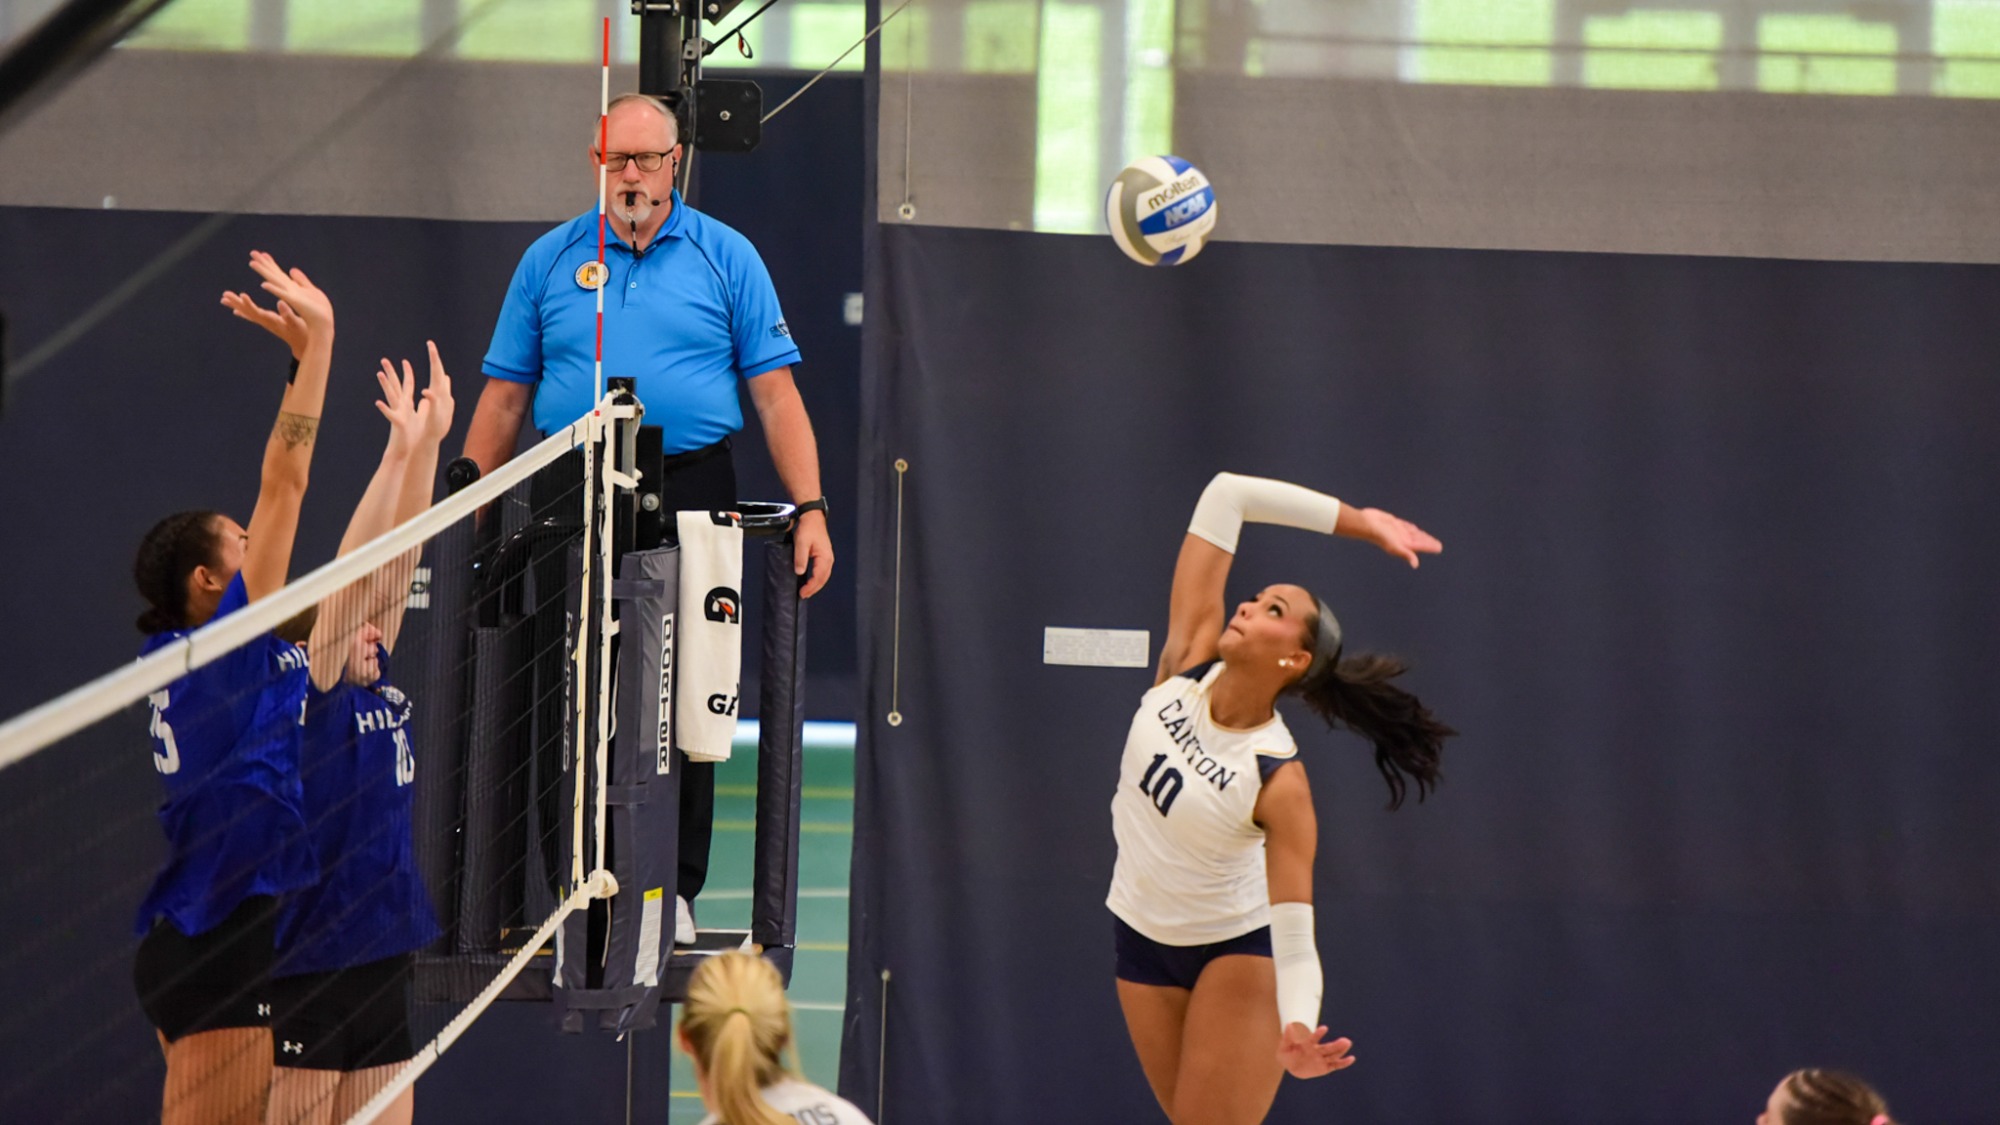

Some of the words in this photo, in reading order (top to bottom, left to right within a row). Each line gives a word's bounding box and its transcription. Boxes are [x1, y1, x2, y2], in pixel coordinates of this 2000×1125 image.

[1148, 175, 1200, 210] molten
[1163, 191, 1207, 229] NCAA
[704, 586, 740, 624] G
[392, 728, 415, 787] 10
[1157, 699, 1237, 792] CANTON
[1139, 753, 1183, 818] 10
